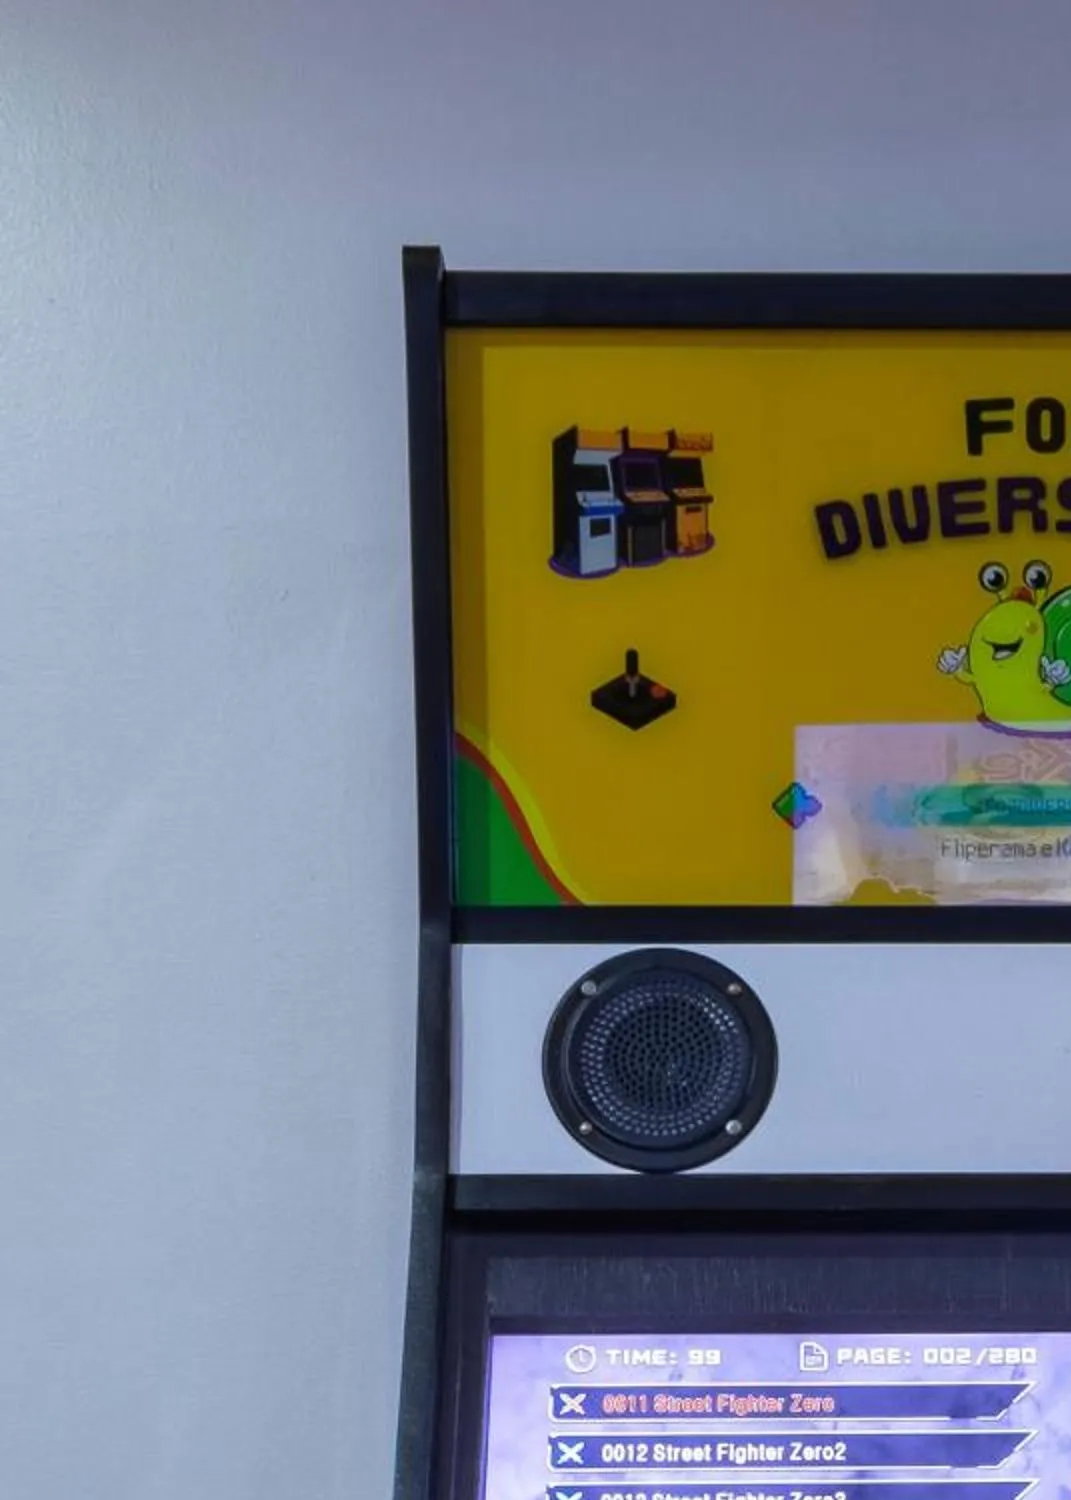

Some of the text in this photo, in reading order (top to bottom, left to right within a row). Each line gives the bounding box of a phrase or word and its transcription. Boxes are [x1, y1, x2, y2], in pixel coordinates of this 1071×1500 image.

[941, 841, 1036, 860] Fliperama
[1041, 844, 1052, 858] e
[606, 1349, 720, 1365] TIME: 99
[836, 1347, 1037, 1365] PAGE: 002/280
[653, 1394, 712, 1413] Street
[717, 1394, 785, 1415] Fighter
[790, 1394, 835, 1412] Zero
[602, 1442, 847, 1464] 0012 Street Fighter Zero2
